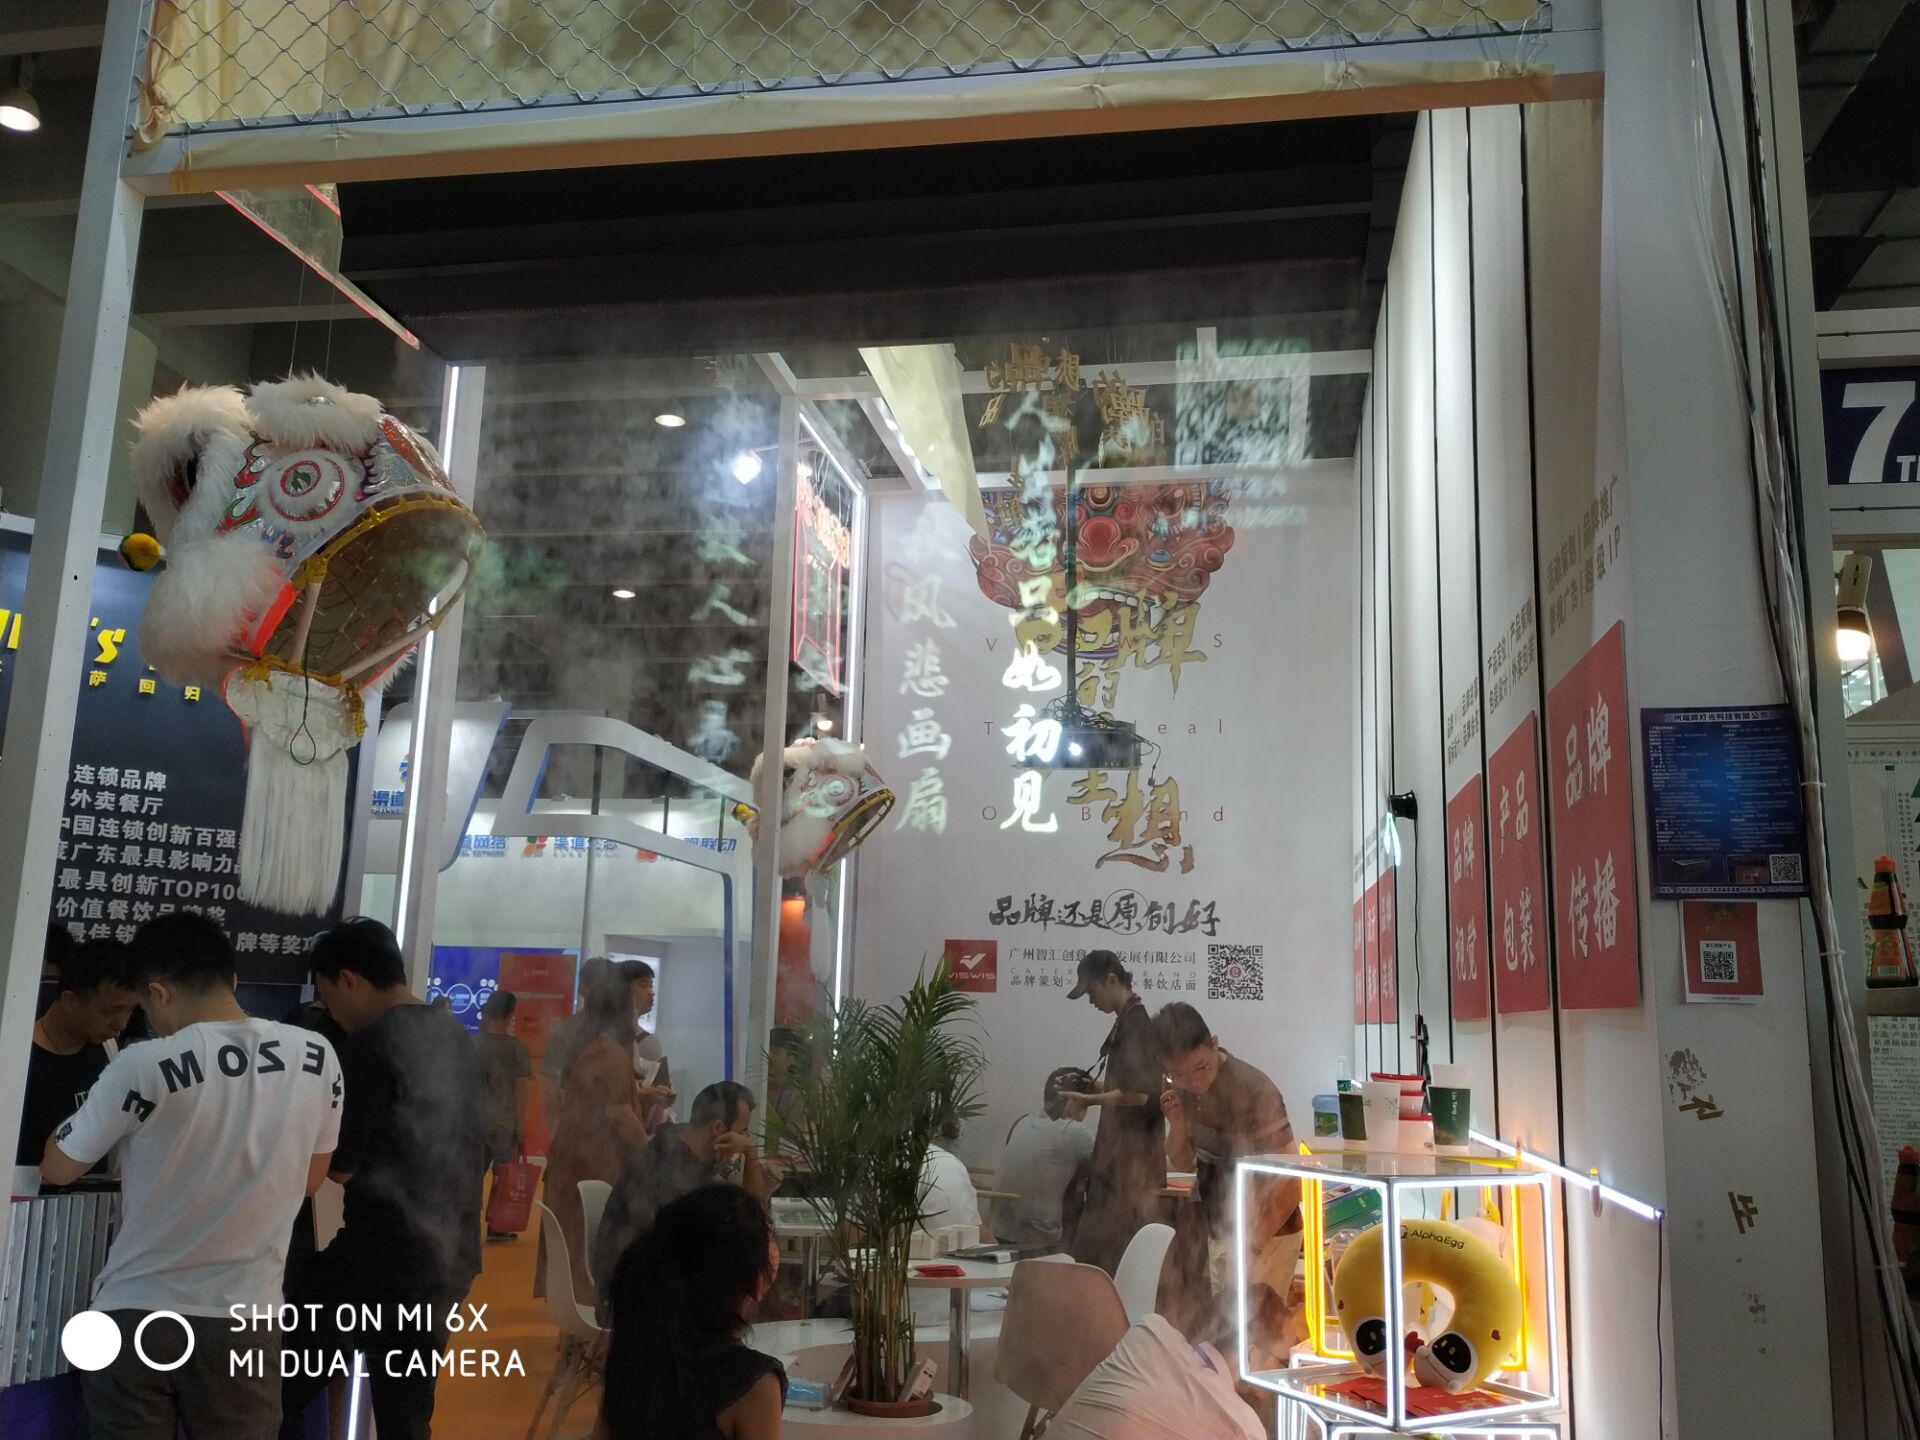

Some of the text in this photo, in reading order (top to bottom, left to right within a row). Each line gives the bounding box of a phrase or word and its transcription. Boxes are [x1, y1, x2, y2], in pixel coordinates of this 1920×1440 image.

[1842, 380, 1920, 483] 7T
[72, 763, 168, 793] 连锁品牌
[1564, 690, 1613, 809] 品牌
[59, 813, 243, 850] 国连锁创新百强
[69, 788, 165, 816] 外卖餐厅
[1498, 767, 1530, 858] 产品
[1453, 813, 1476, 884] 品牌
[988, 892, 1222, 937] 品牌还是原创好
[1502, 886, 1537, 974] 包装
[1567, 850, 1621, 959] 传播
[1008, 946, 1197, 965] 广州智汇创意发展有限公司
